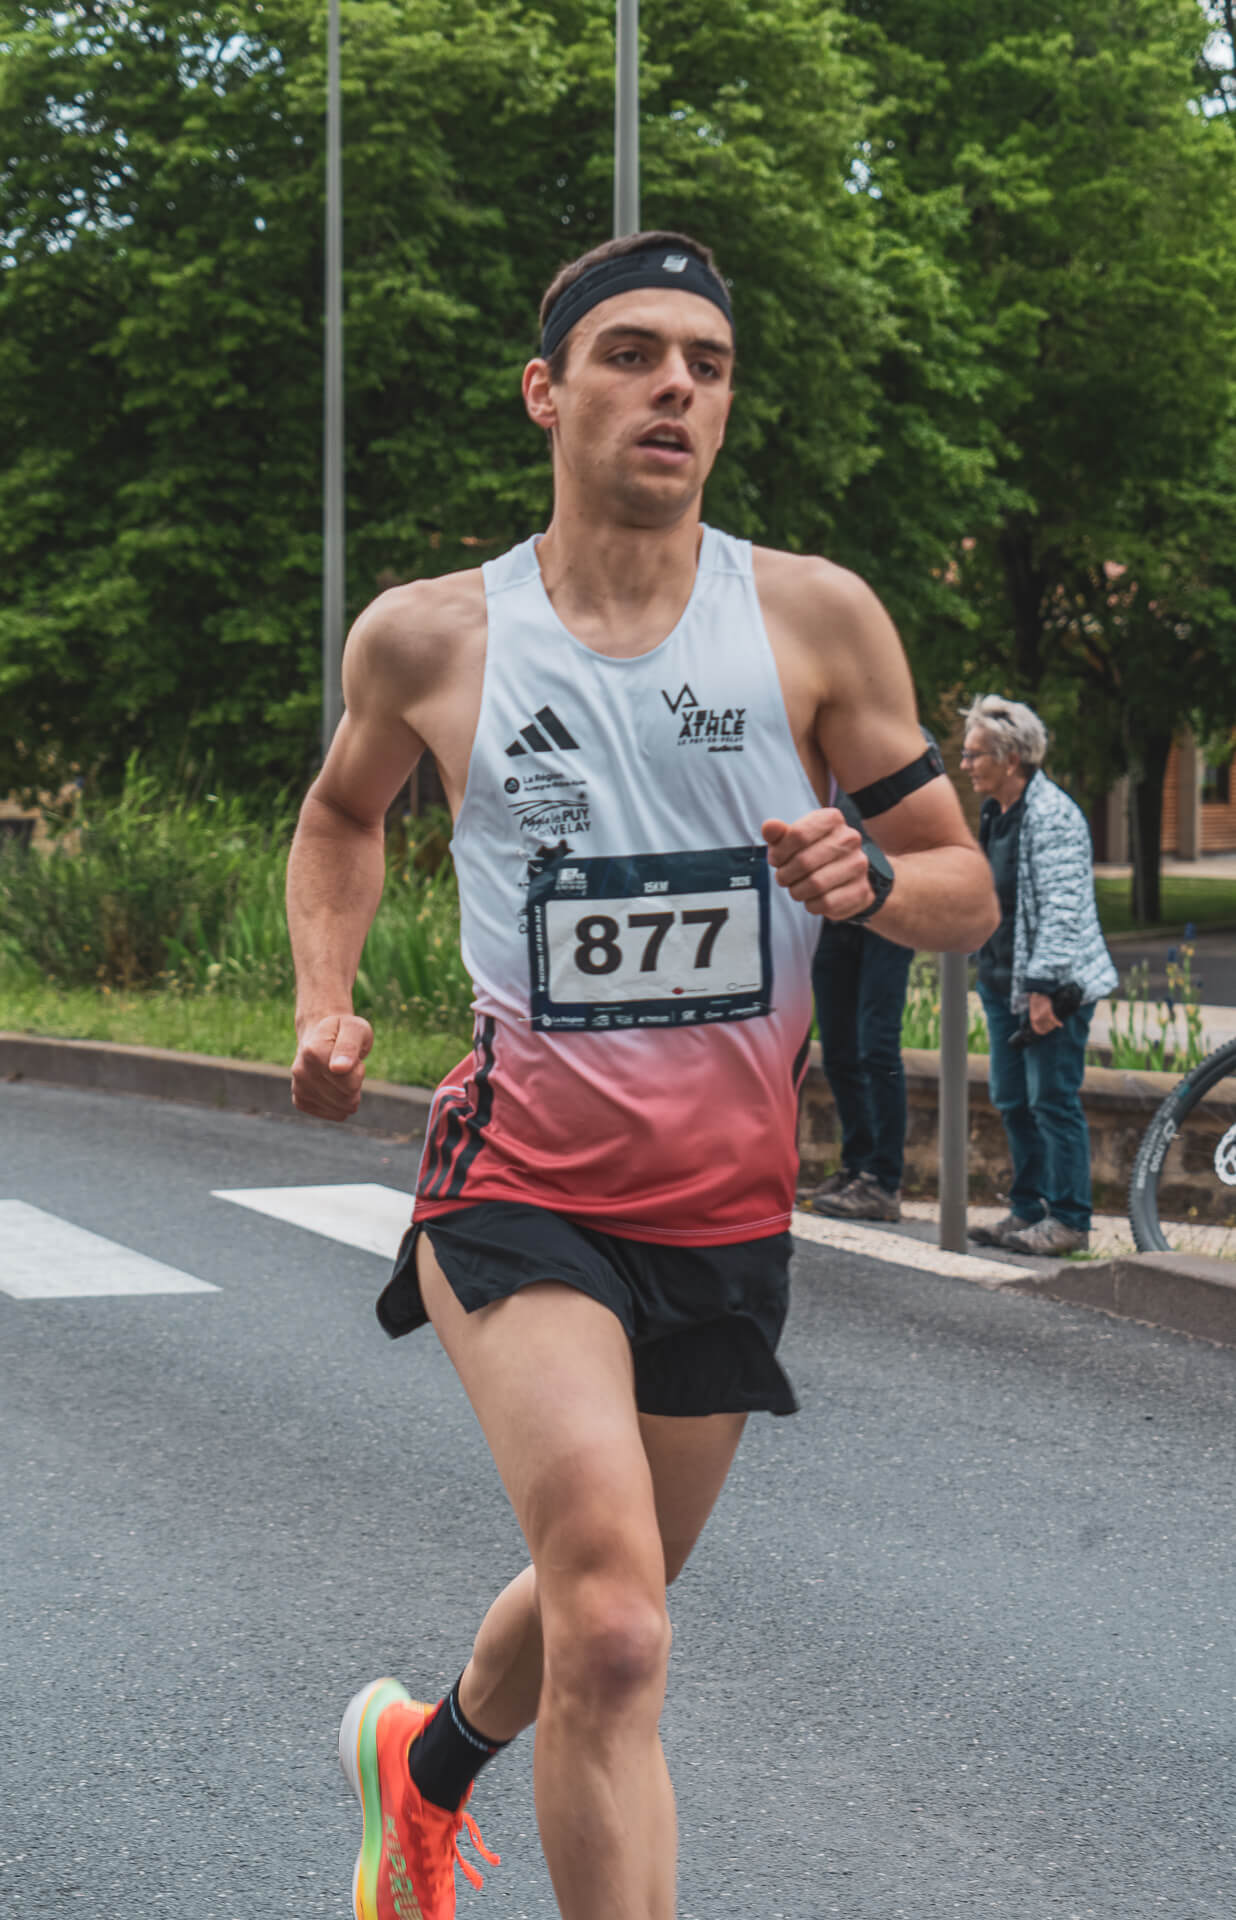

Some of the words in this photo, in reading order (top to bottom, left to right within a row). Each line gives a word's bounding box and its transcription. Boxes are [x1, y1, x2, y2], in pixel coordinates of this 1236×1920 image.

[682, 708, 746, 722] VELAY
[679, 720, 745, 738] ATHLE
[562, 807, 590, 822] PUY
[550, 821, 592, 836] VELAY
[574, 907, 729, 976] 877
